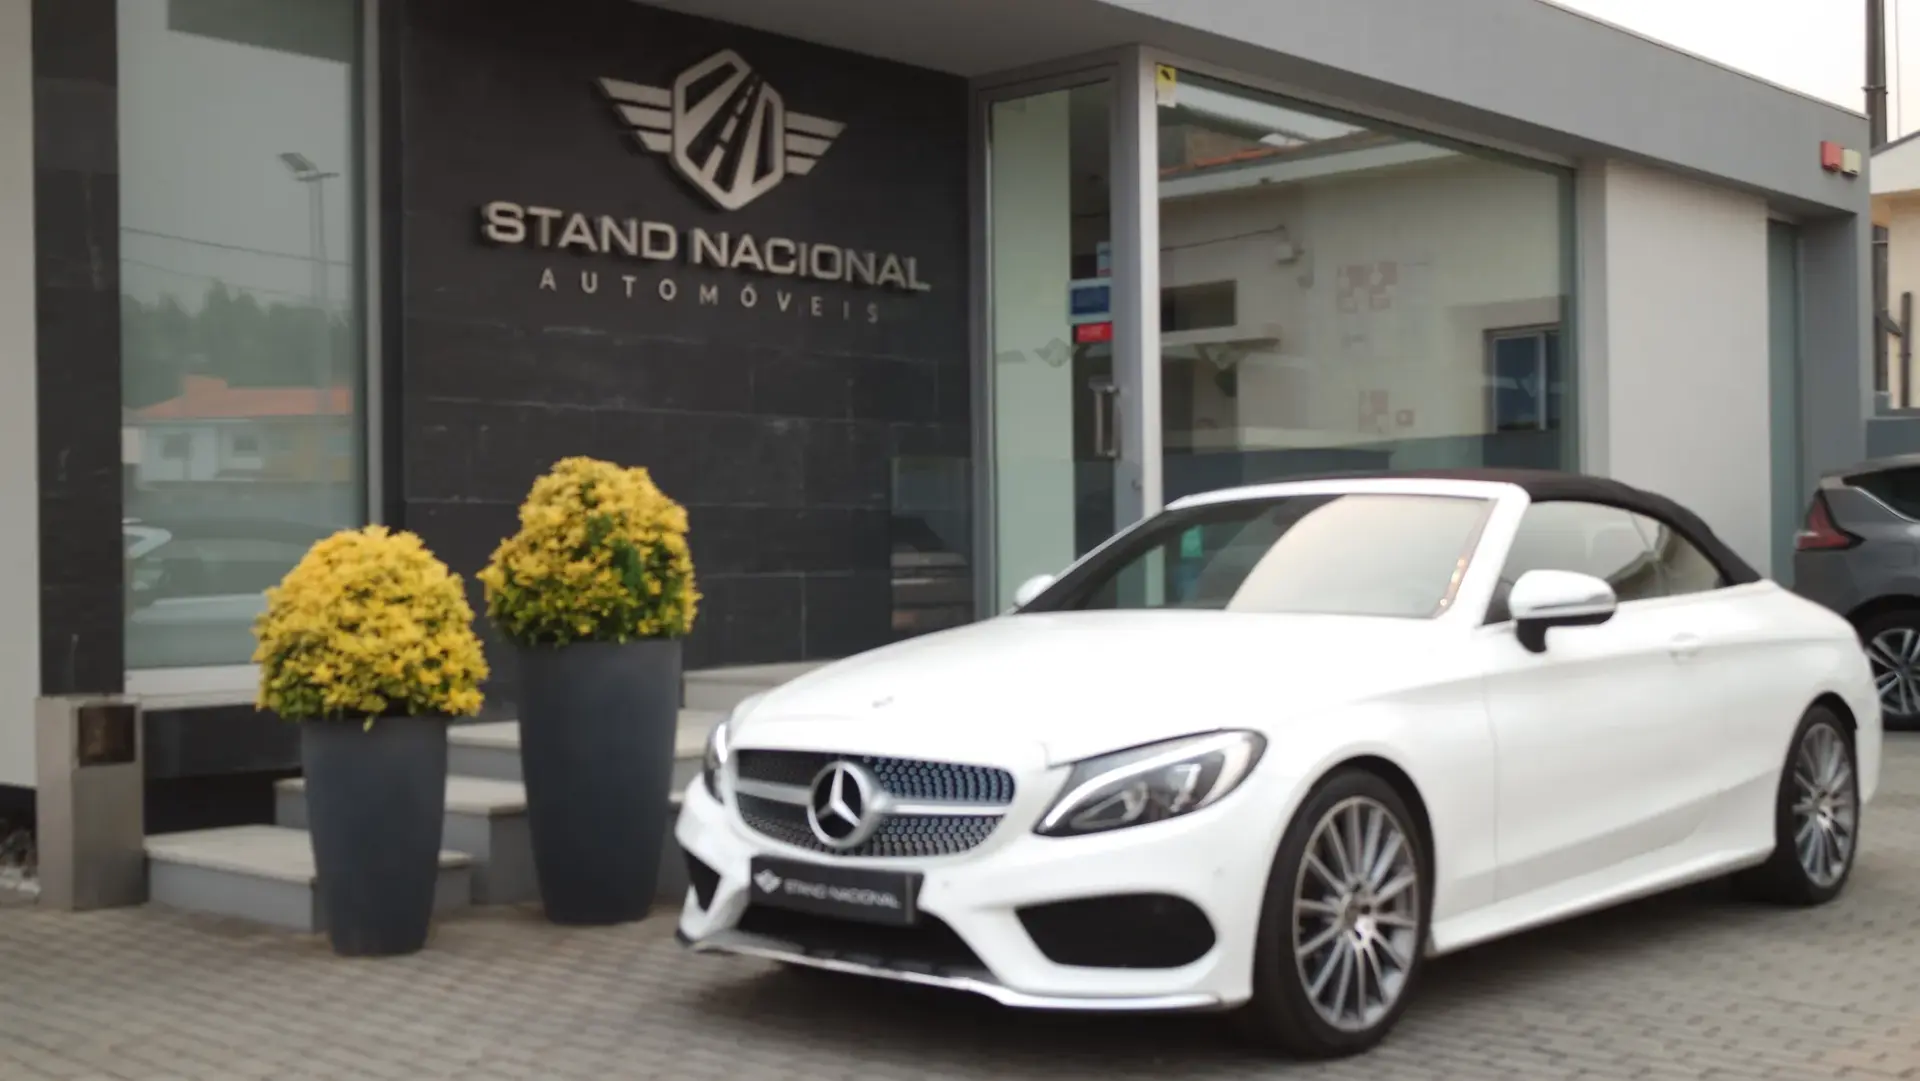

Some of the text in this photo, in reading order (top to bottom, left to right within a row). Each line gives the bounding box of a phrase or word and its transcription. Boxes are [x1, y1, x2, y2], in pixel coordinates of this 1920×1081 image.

[485, 201, 931, 291] STAND NACIONAL
[539, 267, 880, 323] AUTOMÓVEIS
